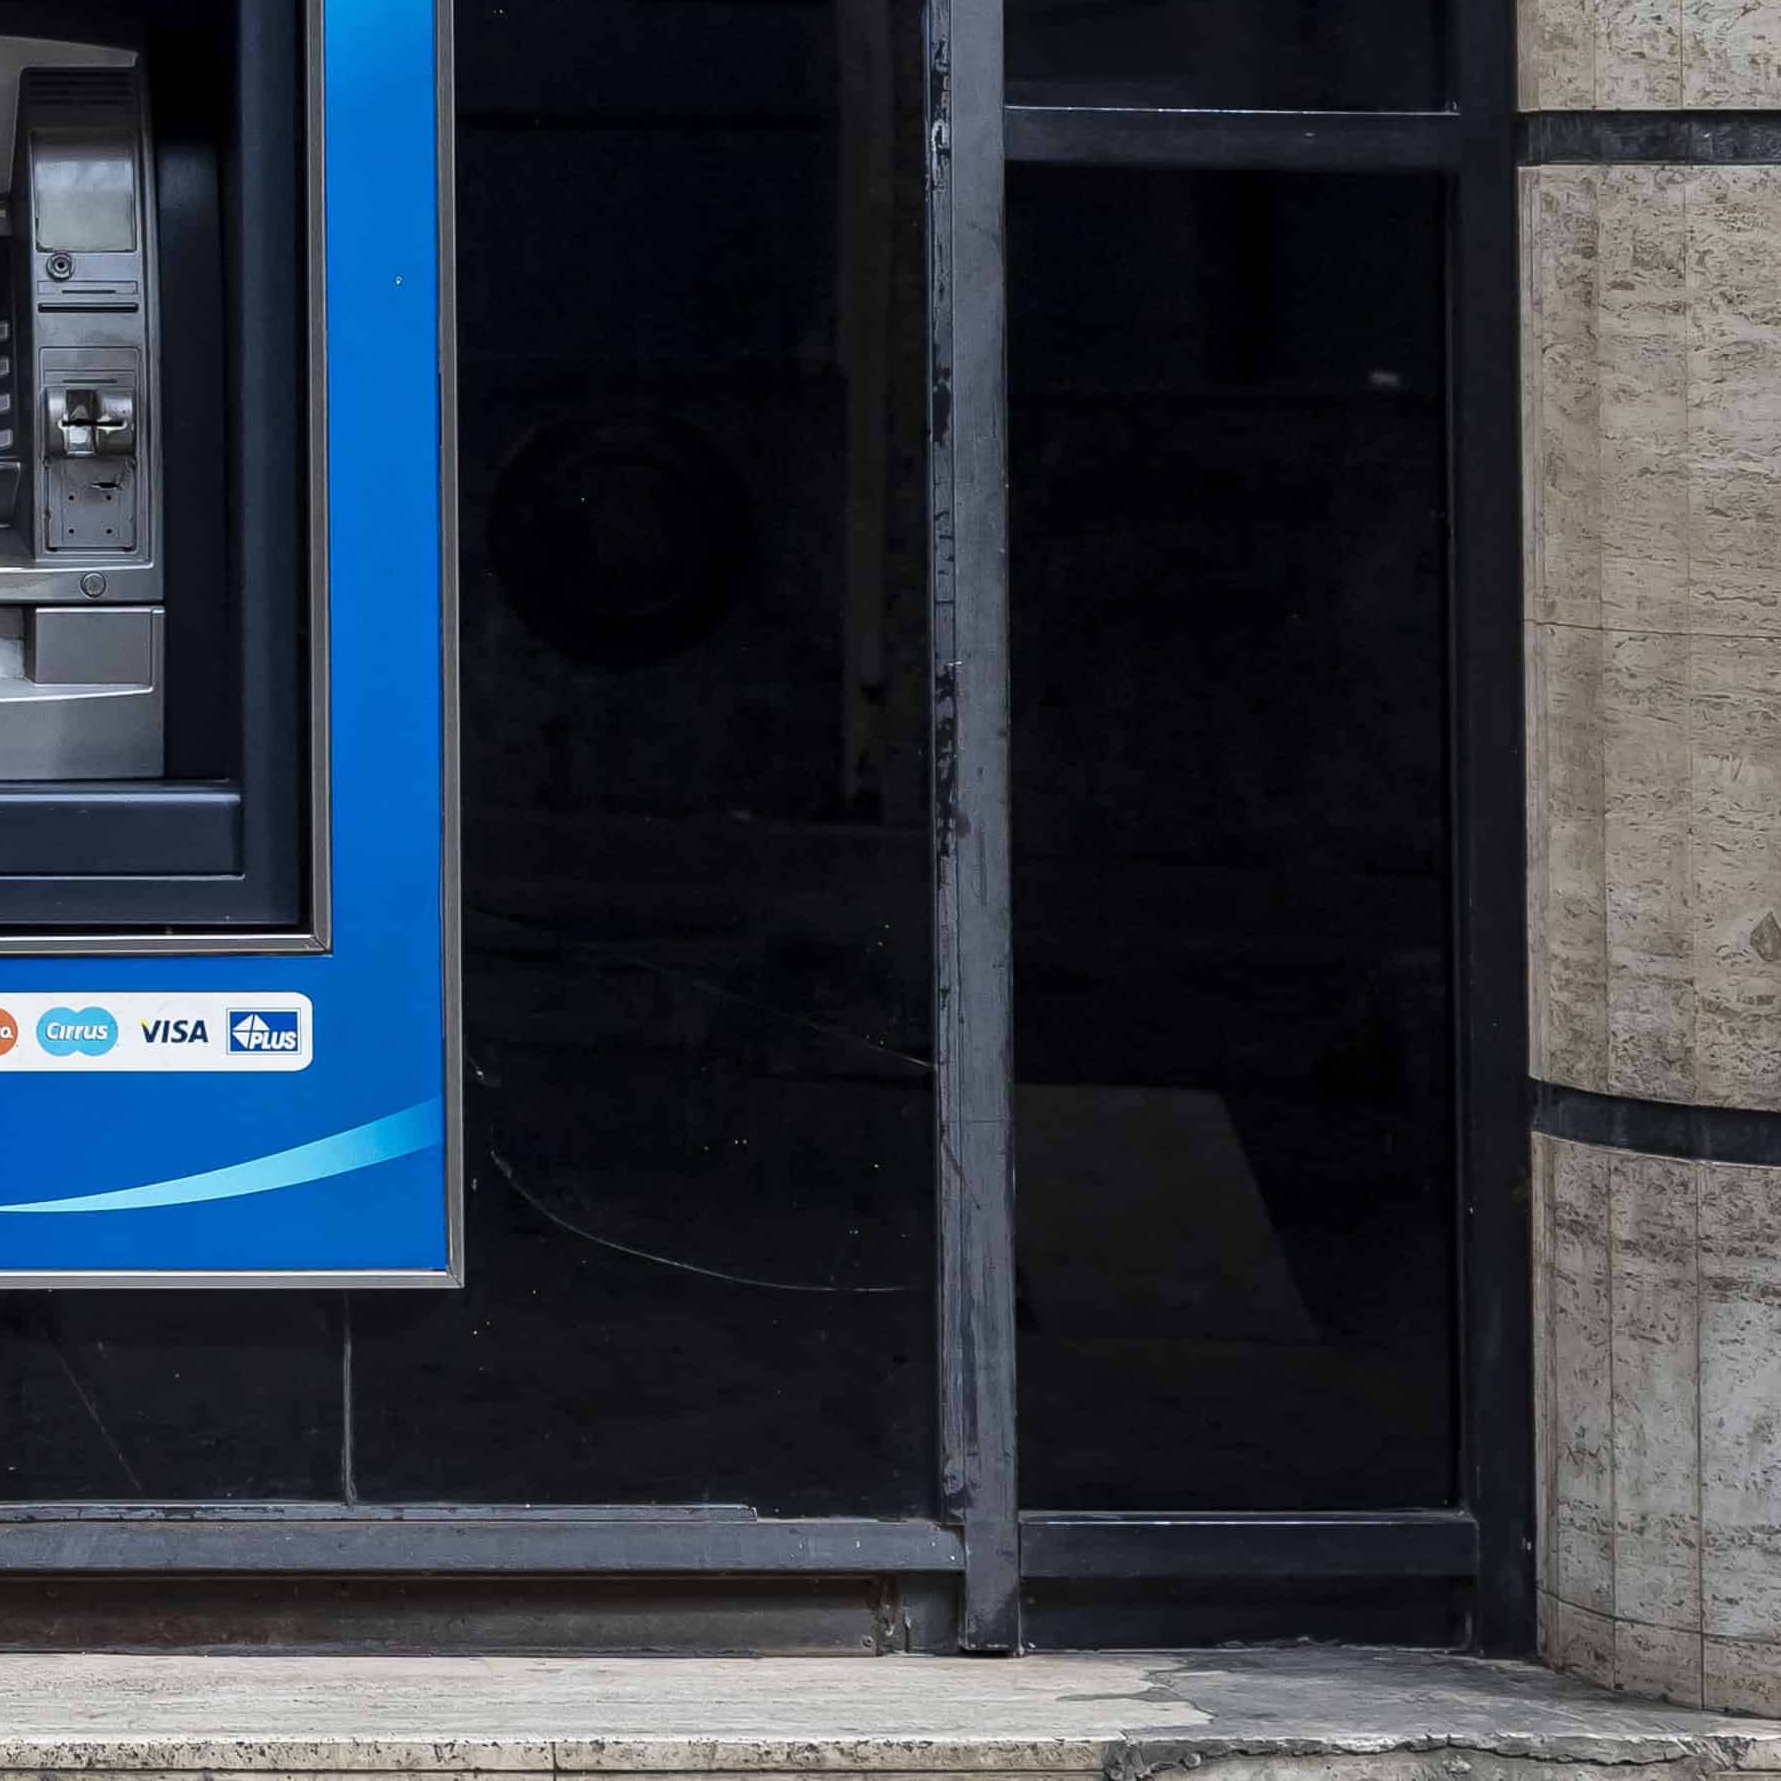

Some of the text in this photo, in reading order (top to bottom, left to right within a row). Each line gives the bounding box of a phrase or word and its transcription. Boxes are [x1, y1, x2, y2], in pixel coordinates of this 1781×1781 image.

[46, 1021, 108, 1042] Cirrus
[141, 1019, 209, 1044] VISA
[249, 1031, 297, 1051] PLUS
